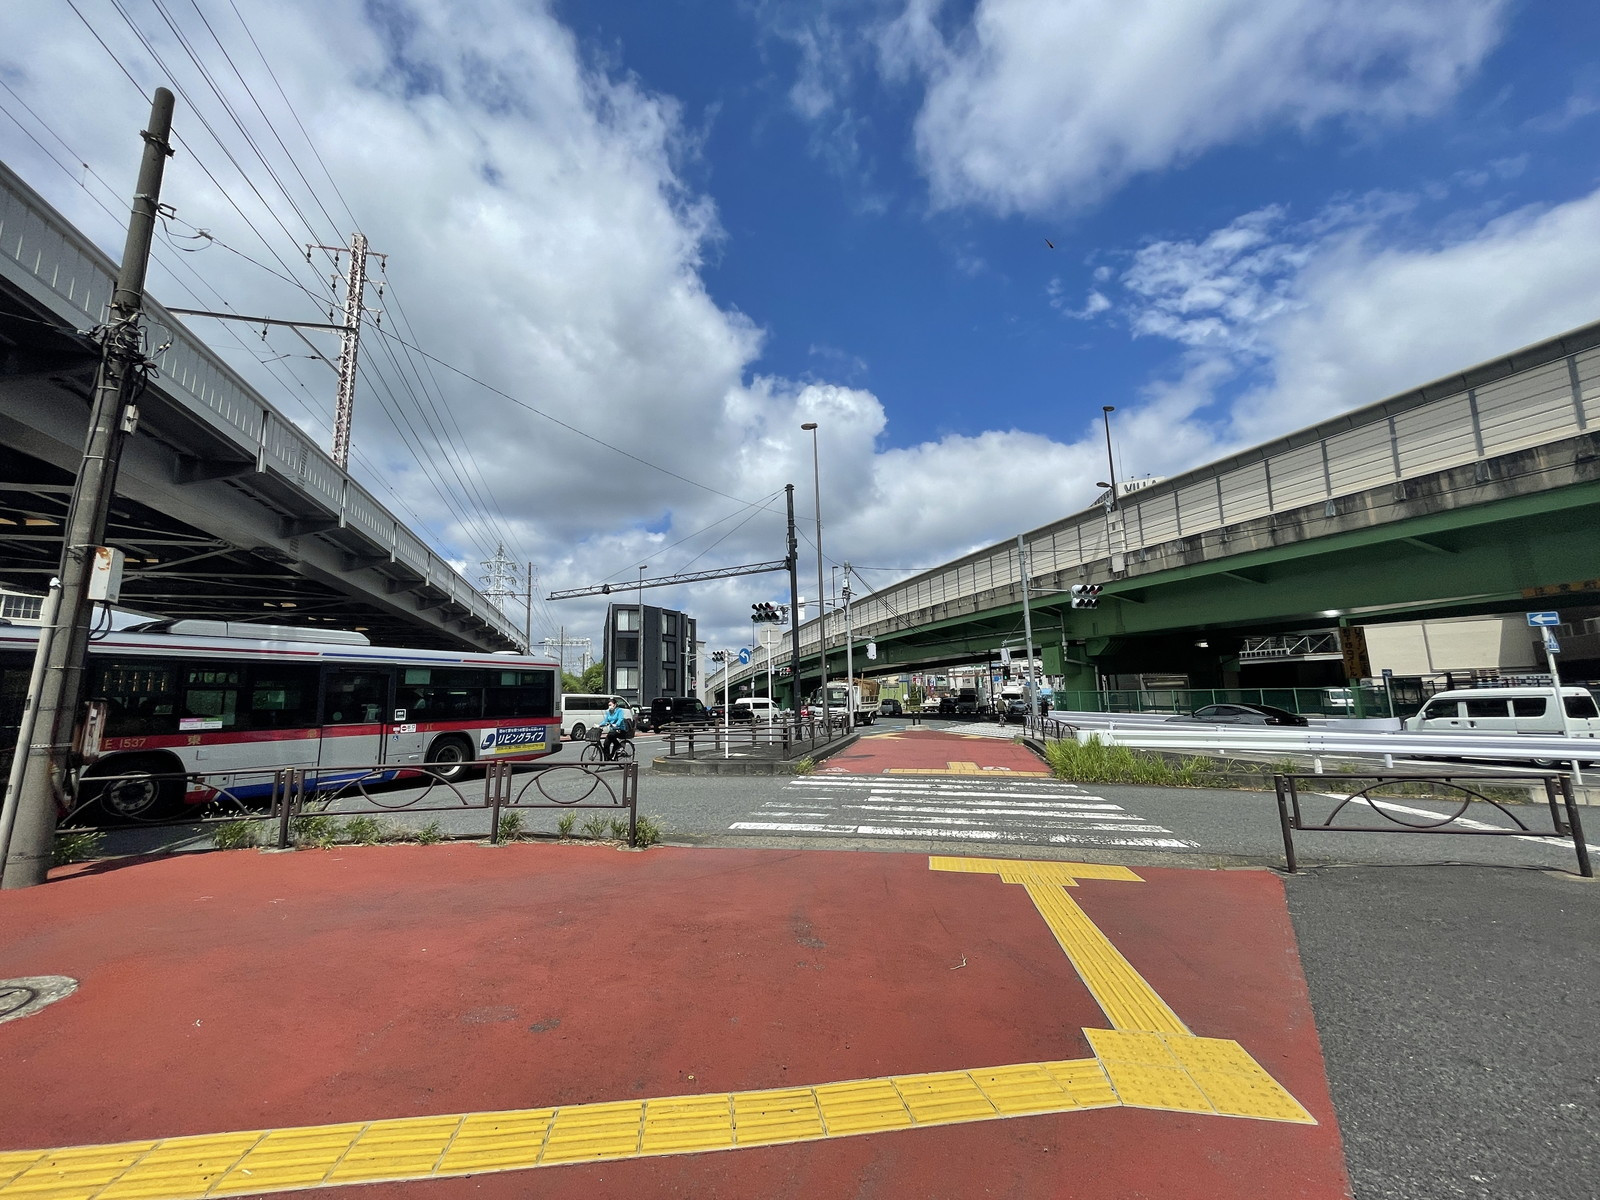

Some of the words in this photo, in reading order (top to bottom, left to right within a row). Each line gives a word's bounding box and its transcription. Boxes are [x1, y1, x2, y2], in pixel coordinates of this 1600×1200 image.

[120, 738, 146, 748] 1537
[498, 732, 544, 744] リビングライフ
